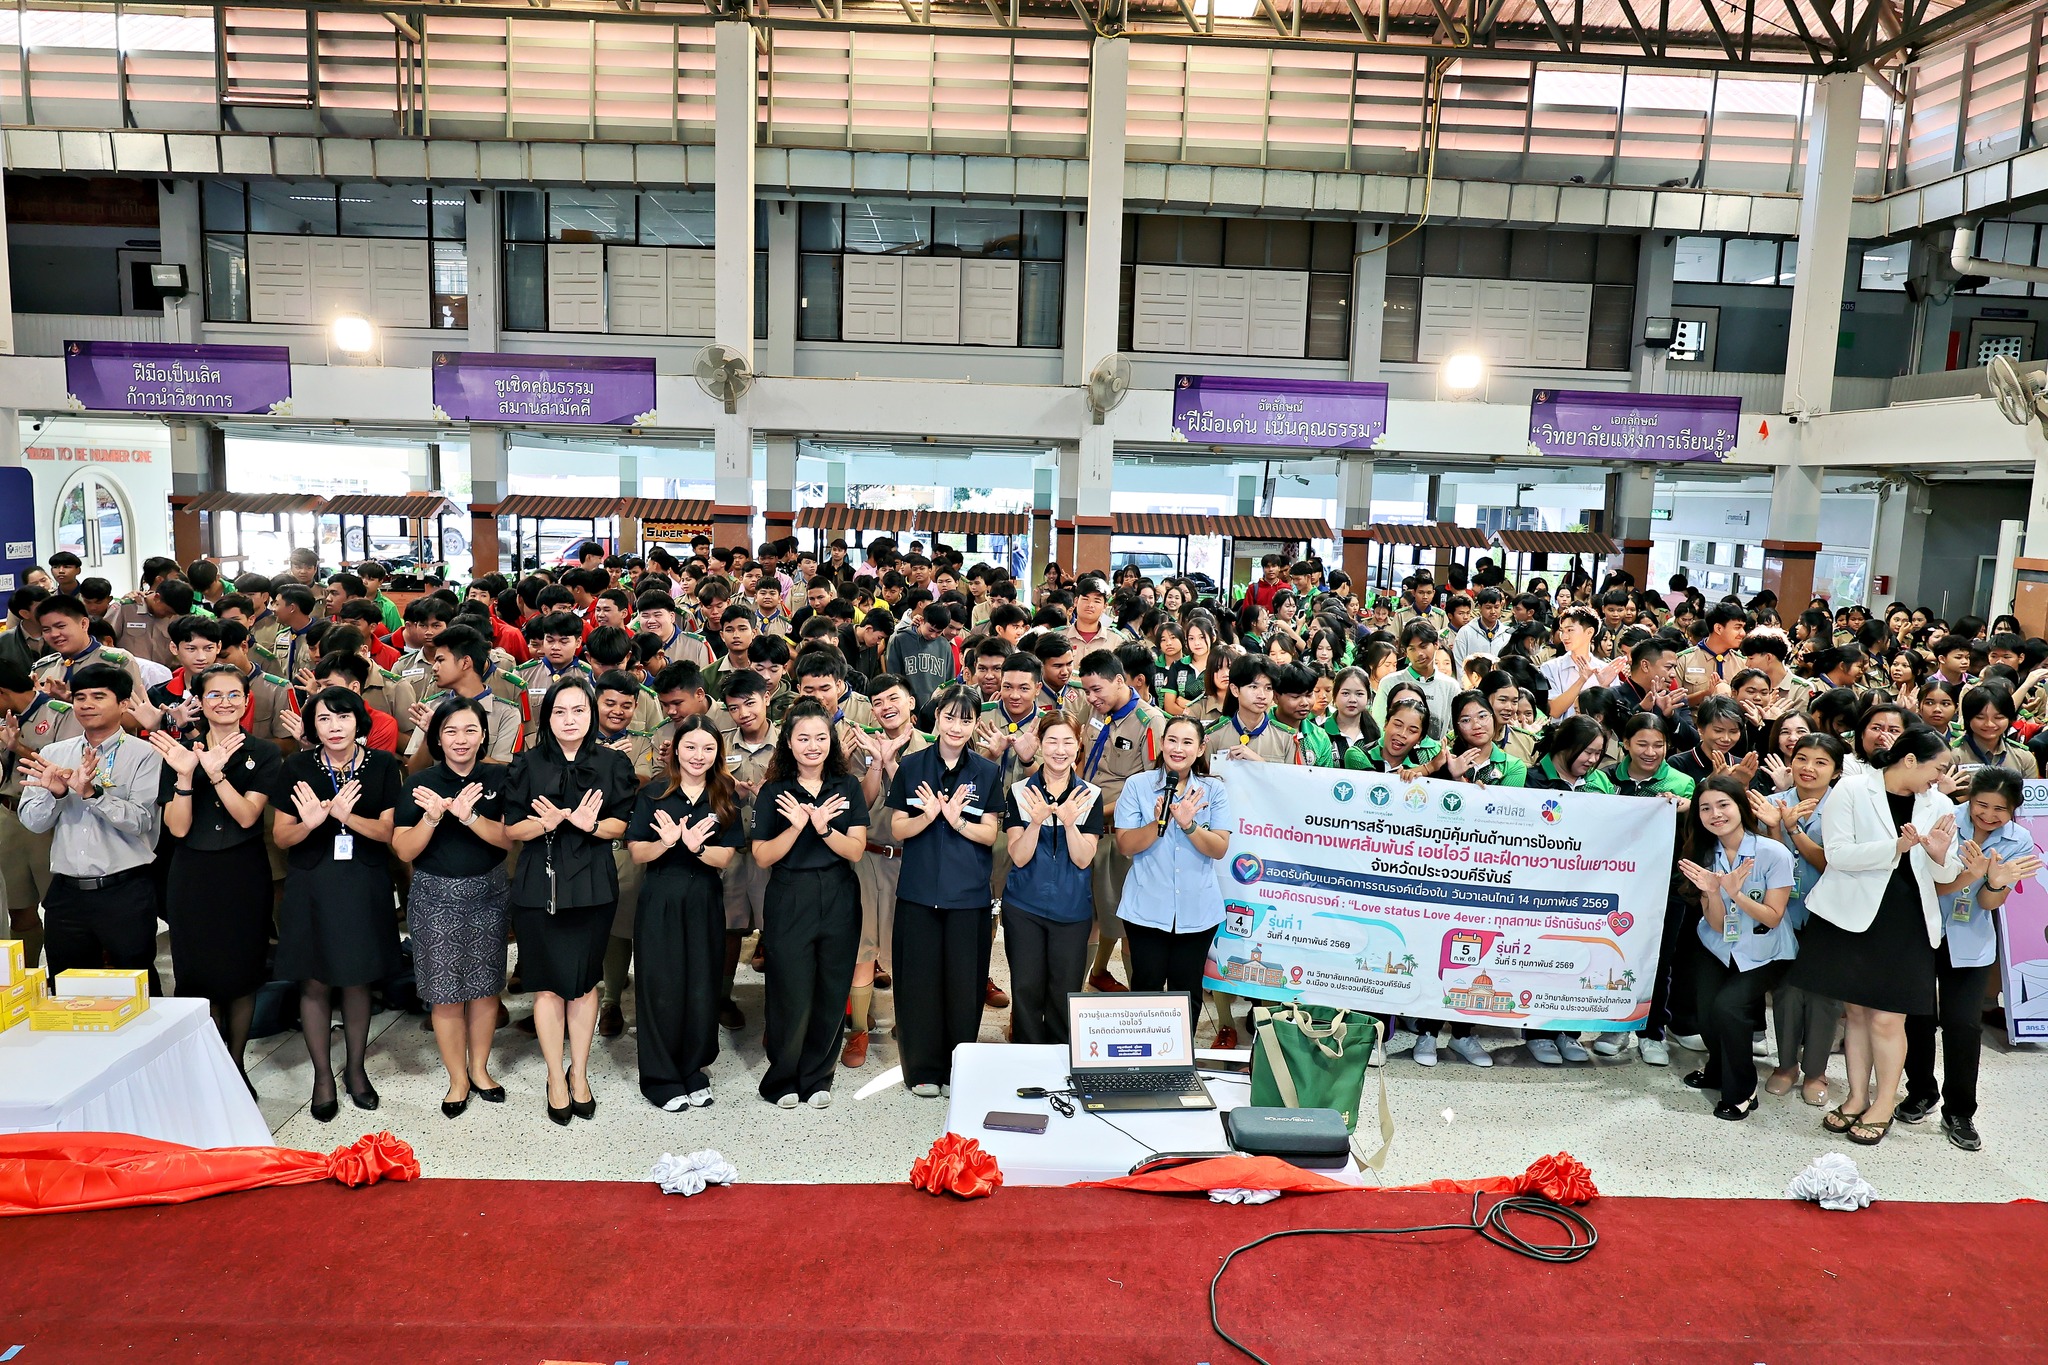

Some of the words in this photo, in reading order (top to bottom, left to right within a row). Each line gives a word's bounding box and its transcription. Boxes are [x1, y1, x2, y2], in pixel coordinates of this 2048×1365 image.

[133, 362, 221, 383] ฝีมือเป็นเลิศ
[494, 375, 594, 399] ชูเชิดคุณธรรม
[126, 387, 233, 408] ก้าวนำวิชาการ
[1258, 399, 1304, 412] อัตลักษณ์
[499, 398, 591, 416] สมานสามัคคี
[1178, 410, 1257, 434] “ฝีมือเด่น
[1611, 414, 1658, 426] เอกลักษณ์
[57, 447, 72, 460] TO
[905, 653, 945, 677] RUN
[1304, 814, 1582, 851] อบรมการสร้างเสริมภูมิคุ้มกันด้านการป้องกัน
[1238, 818, 1414, 857] โรคติดต่อทางเพศสัมพันธ์
[1418, 844, 1470, 862] เอชไอวี
[1474, 851, 1636, 873] และฝีดาษวานรในเยาวชน
[1371, 858, 1513, 884] จังหวัดประจวบคีรีขันธ์
[1266, 866, 1448, 898] สอดรับกับแนวคิดการรณรงค์เนื่องใน
[1452, 889, 1514, 904] วันวาเลนไทน์
[1518, 895, 1529, 905] 14
[1533, 896, 1579, 908] กุมภาพันธ์
[1582, 897, 1609, 909] 2569
[1259, 888, 1340, 908] แนวคิดรณรงค์
[1348, 899, 1381, 913] “Love
[1384, 905, 1420, 918] status
[1424, 909, 1450, 921] Love
[1454, 912, 1485, 924] 4ever
[1494, 916, 1542, 929] ทุกสถานะ
[1235, 916, 1243, 927] 4
[1269, 914, 1294, 930] รุ่นที่
[1298, 920, 1302, 930] 1
[1267, 930, 1283, 940] วันที่
[1291, 936, 1328, 946] กุมภาพันธ์
[1330, 939, 1351, 949] 2569
[1496, 939, 1520, 956] รุ่นที่
[1523, 944, 1531, 955] 2
[1462, 944, 1470, 955] 5
[1494, 956, 1510, 966] วันที่
[1518, 958, 1553, 969] กุมภาพันธ์
[1555, 961, 1575, 969] 2569
[1316, 971, 1411, 989] วิทยาลัยเทคนิคประจวบคีรีขันธ์
[1078, 1008, 1182, 1020] ความรู้และการป้องกันโรคติดเชื้อ
[1088, 1026, 1171, 1035] โรคติดต่อทางเพศสัมพันธ์
